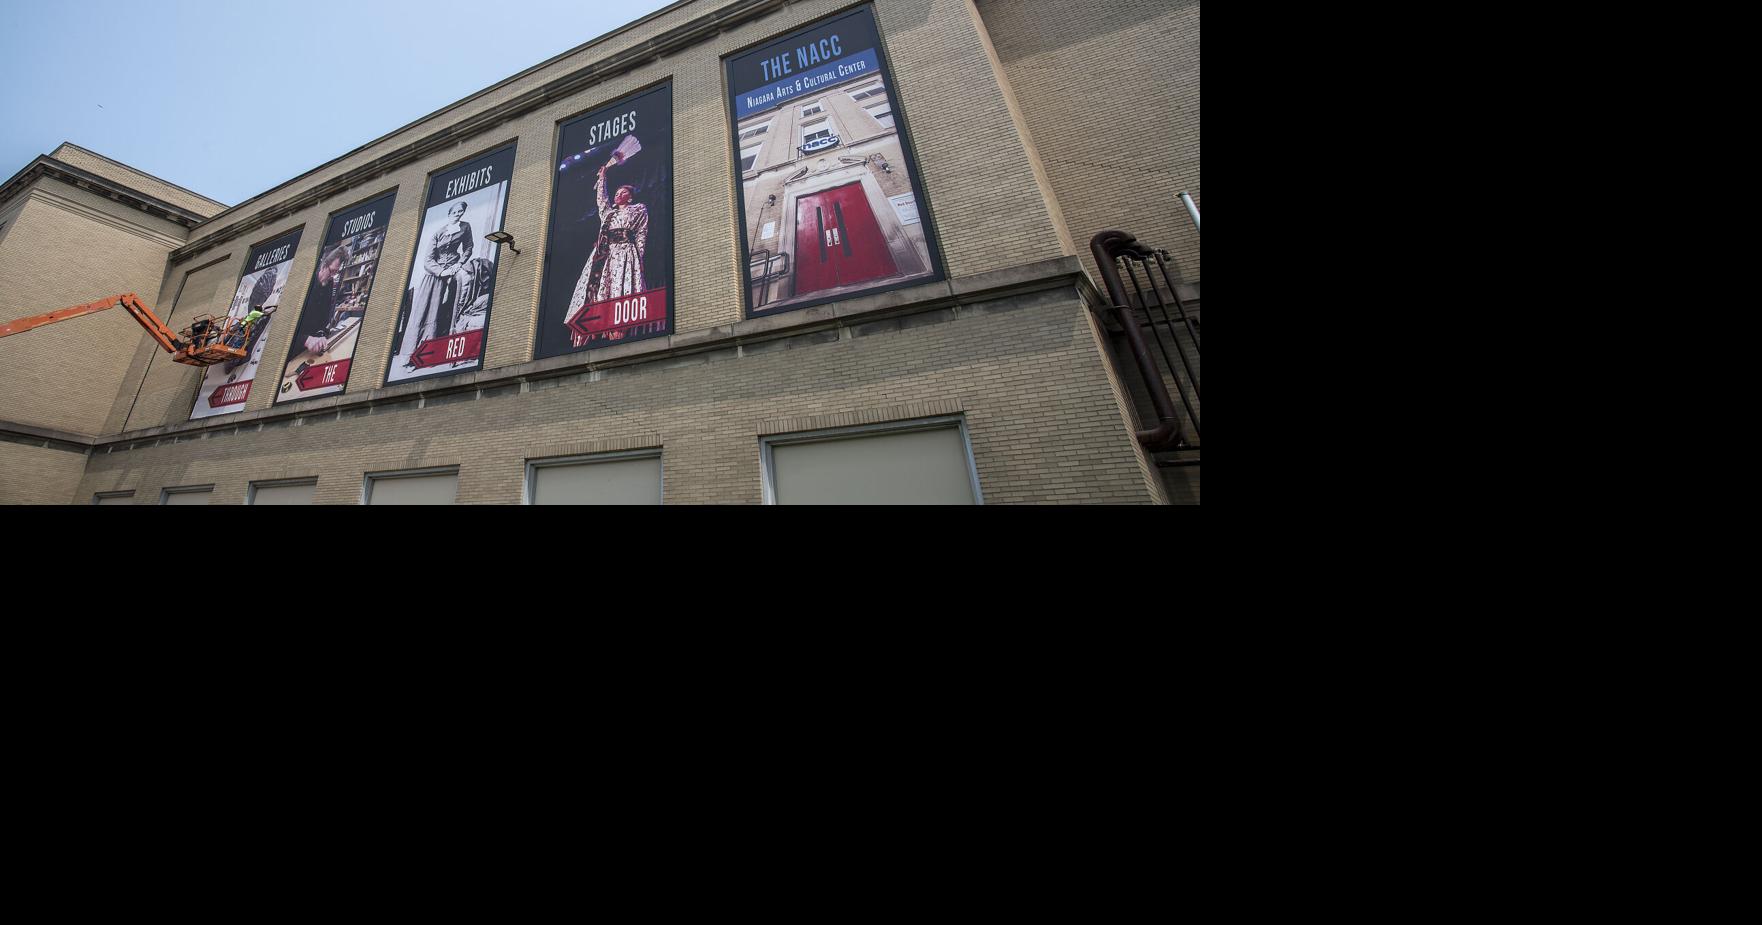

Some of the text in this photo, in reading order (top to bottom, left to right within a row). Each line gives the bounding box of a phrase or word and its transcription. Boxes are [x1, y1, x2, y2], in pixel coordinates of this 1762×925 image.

[761, 35, 842, 81] THE NACC
[795, 79, 801, 92] &
[589, 110, 636, 146] STAGES
[802, 135, 837, 150] nacc
[445, 165, 493, 199] EXHIBITS
[341, 210, 376, 238] STUDIOS
[254, 243, 291, 270] GALLERIES
[614, 296, 647, 325] DOOR
[446, 336, 466, 359] RED
[321, 364, 338, 385] THE
[221, 383, 249, 404] THROUGH
